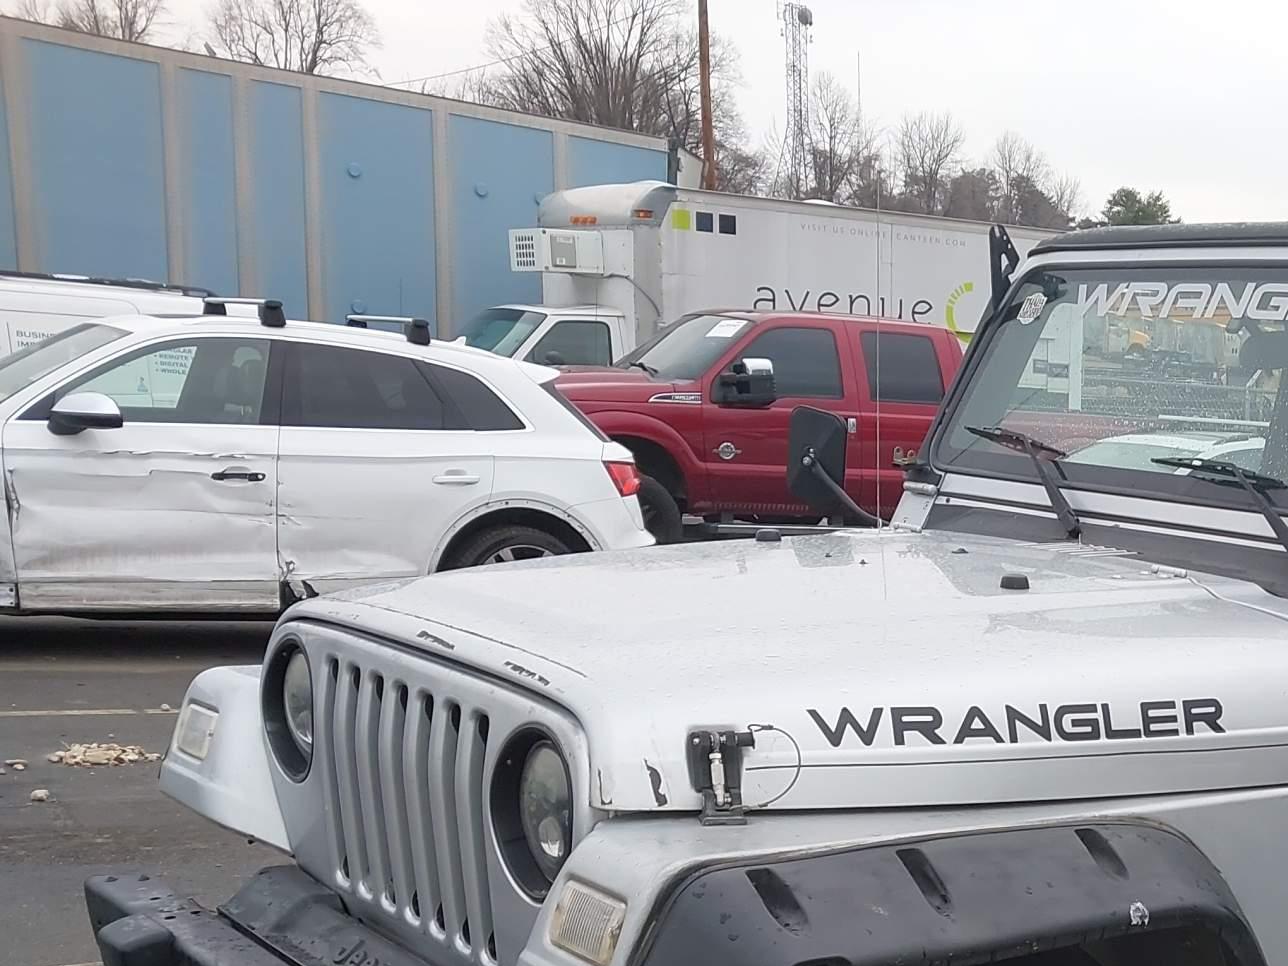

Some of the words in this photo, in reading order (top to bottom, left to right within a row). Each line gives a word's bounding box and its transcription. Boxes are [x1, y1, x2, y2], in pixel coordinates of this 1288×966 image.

[800, 223, 826, 232] VISIT
[832, 226, 845, 234] US
[753, 286, 934, 325] avenue
[806, 697, 1227, 748] WRANGLER
